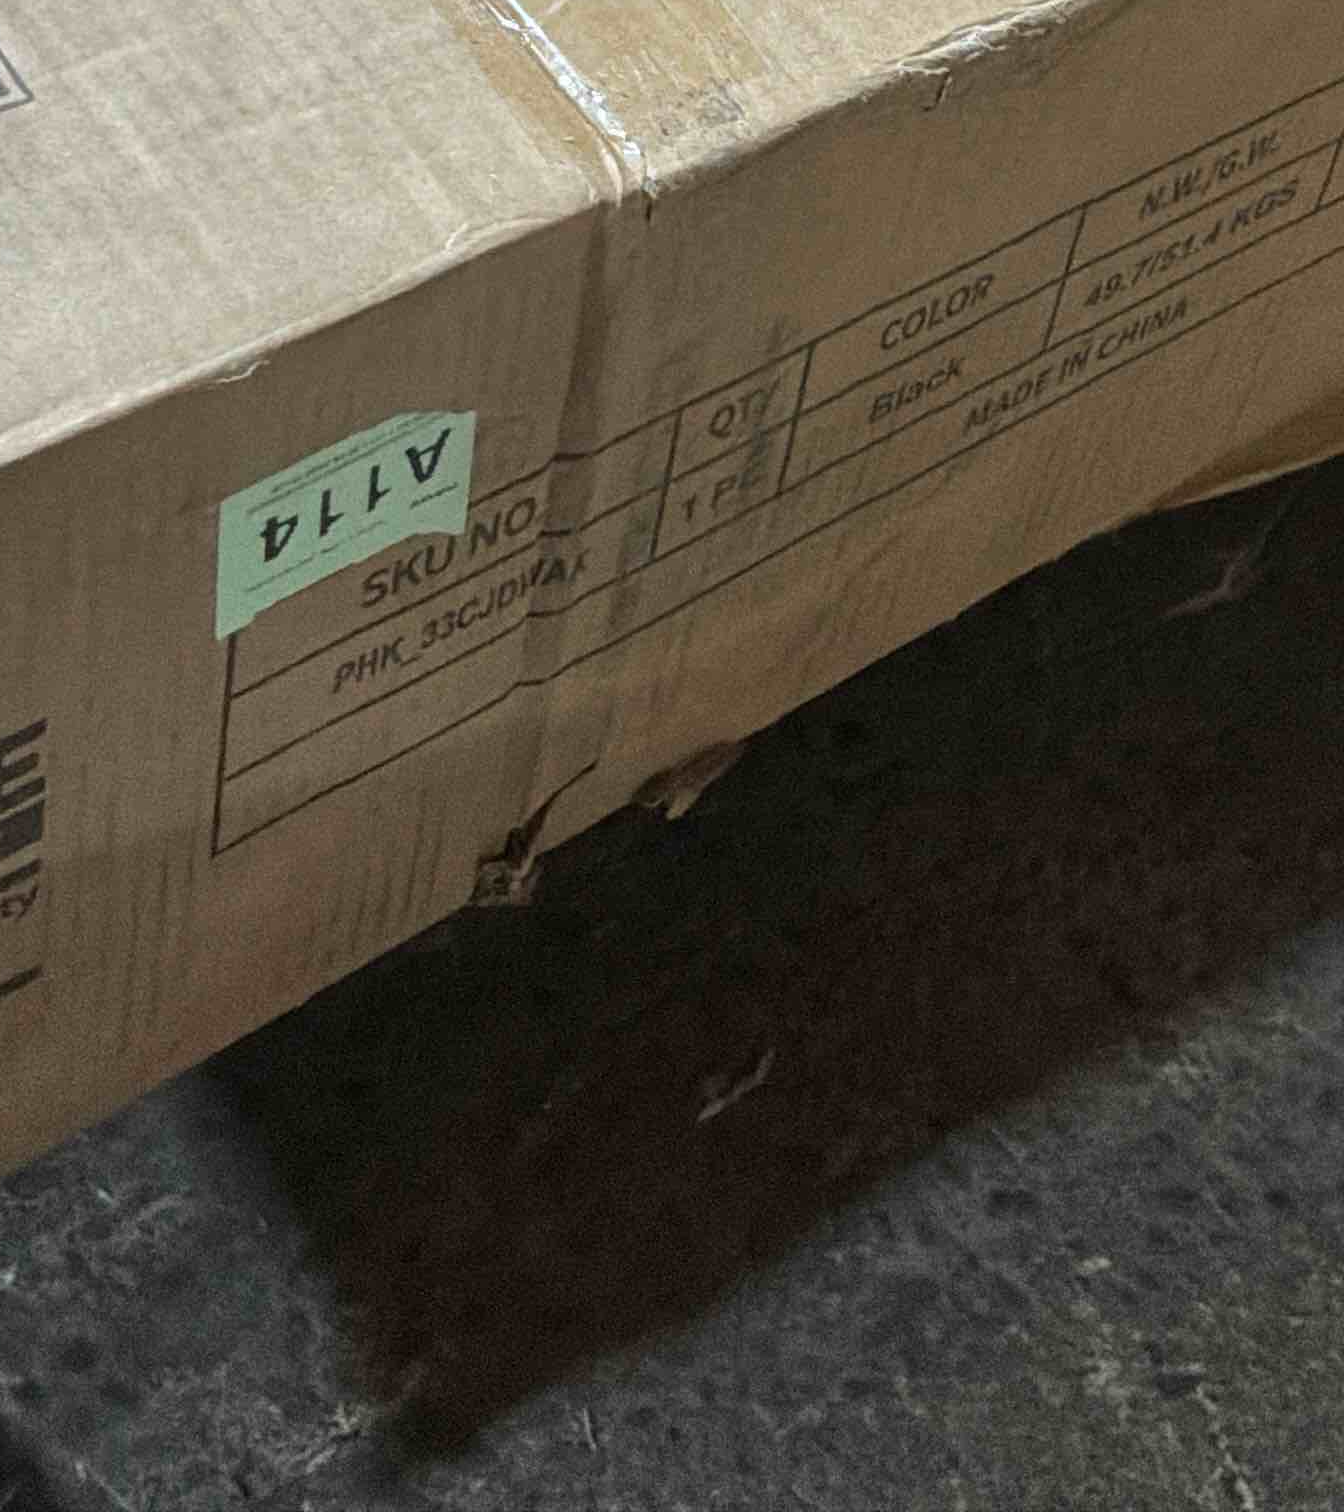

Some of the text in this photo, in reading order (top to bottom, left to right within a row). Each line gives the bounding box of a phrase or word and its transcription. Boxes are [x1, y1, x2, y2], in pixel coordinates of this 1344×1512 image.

[1230, 178, 1301, 232] KGS
[881, 274, 995, 350] COLOR
[870, 355, 965, 424] Black
[962, 296, 1187, 436] MADE IN CHINA
[709, 374, 782, 438] QTY
[260, 427, 452, 562] A114
[361, 535, 455, 609] SKU
